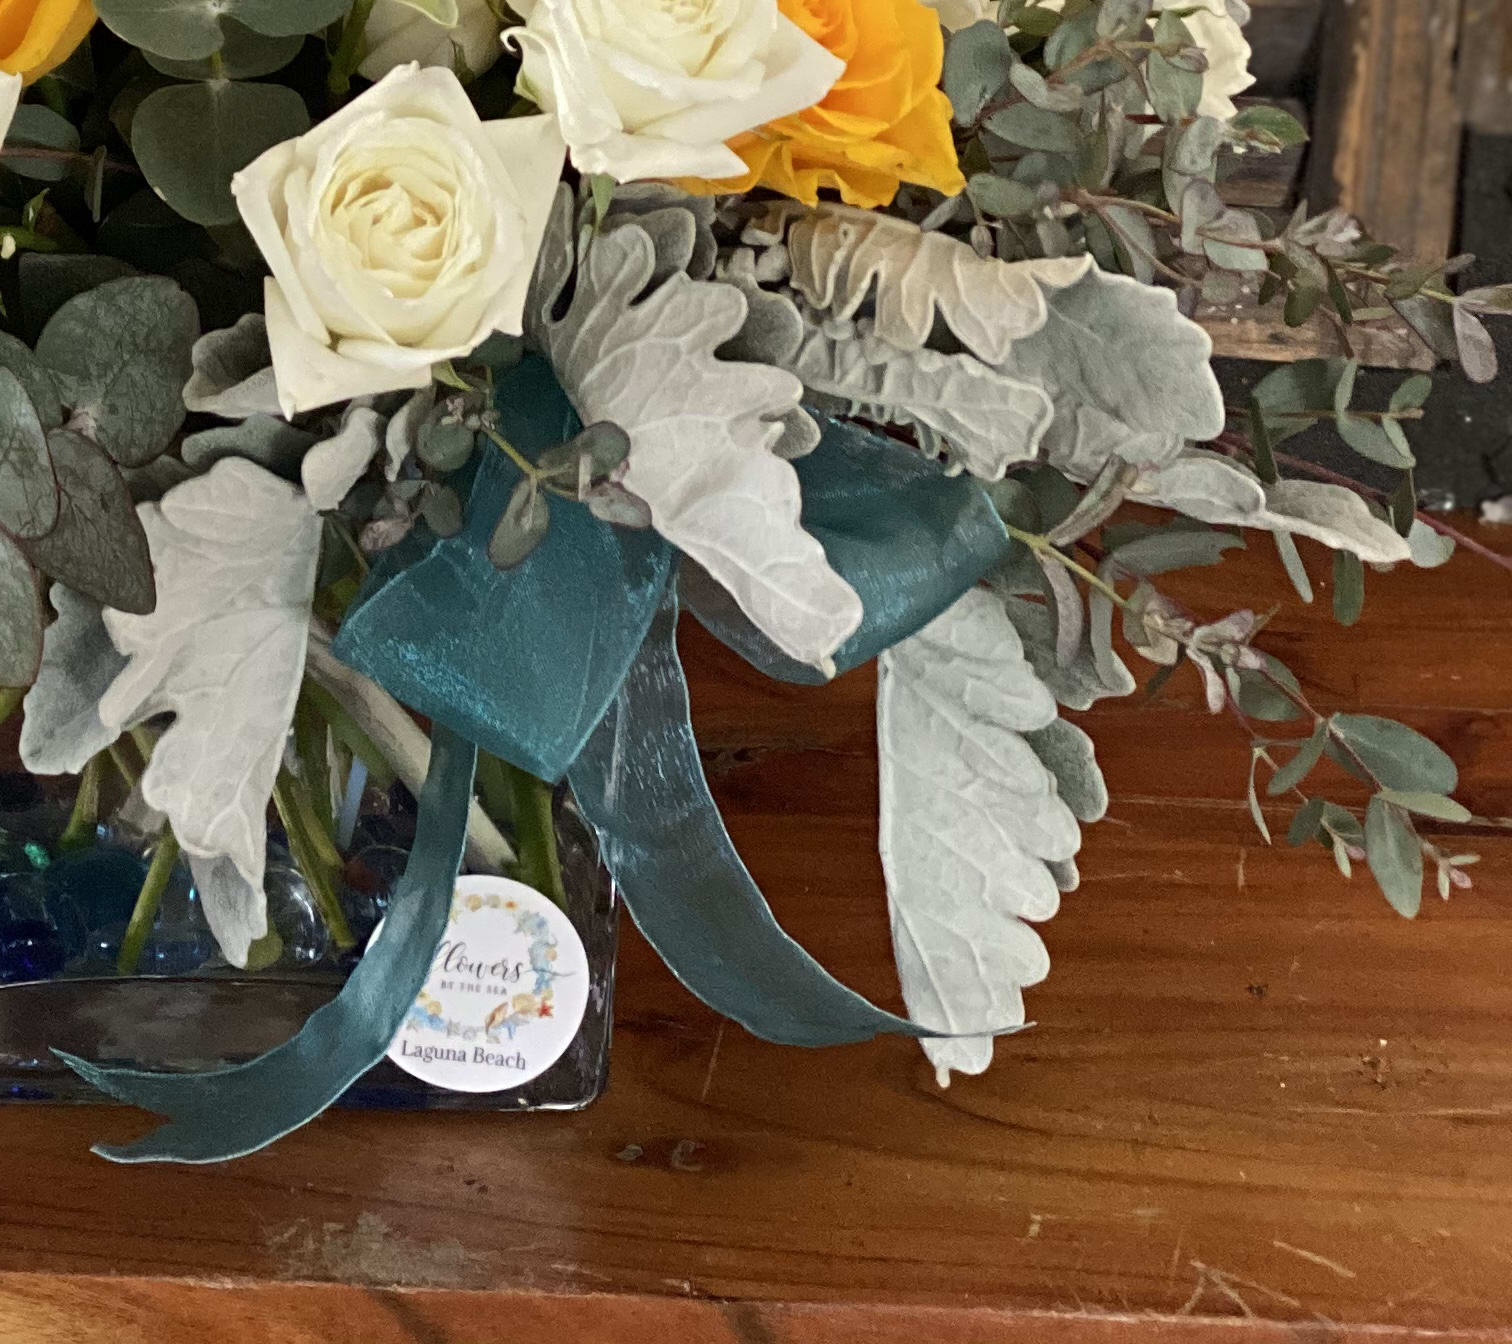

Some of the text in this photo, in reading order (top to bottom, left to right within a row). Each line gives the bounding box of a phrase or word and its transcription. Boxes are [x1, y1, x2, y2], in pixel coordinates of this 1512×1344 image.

[437, 940, 524, 984] lowers
[460, 982, 482, 993] THE
[488, 984, 508, 996] SEA
[401, 1040, 527, 1070] Laguna Beach
